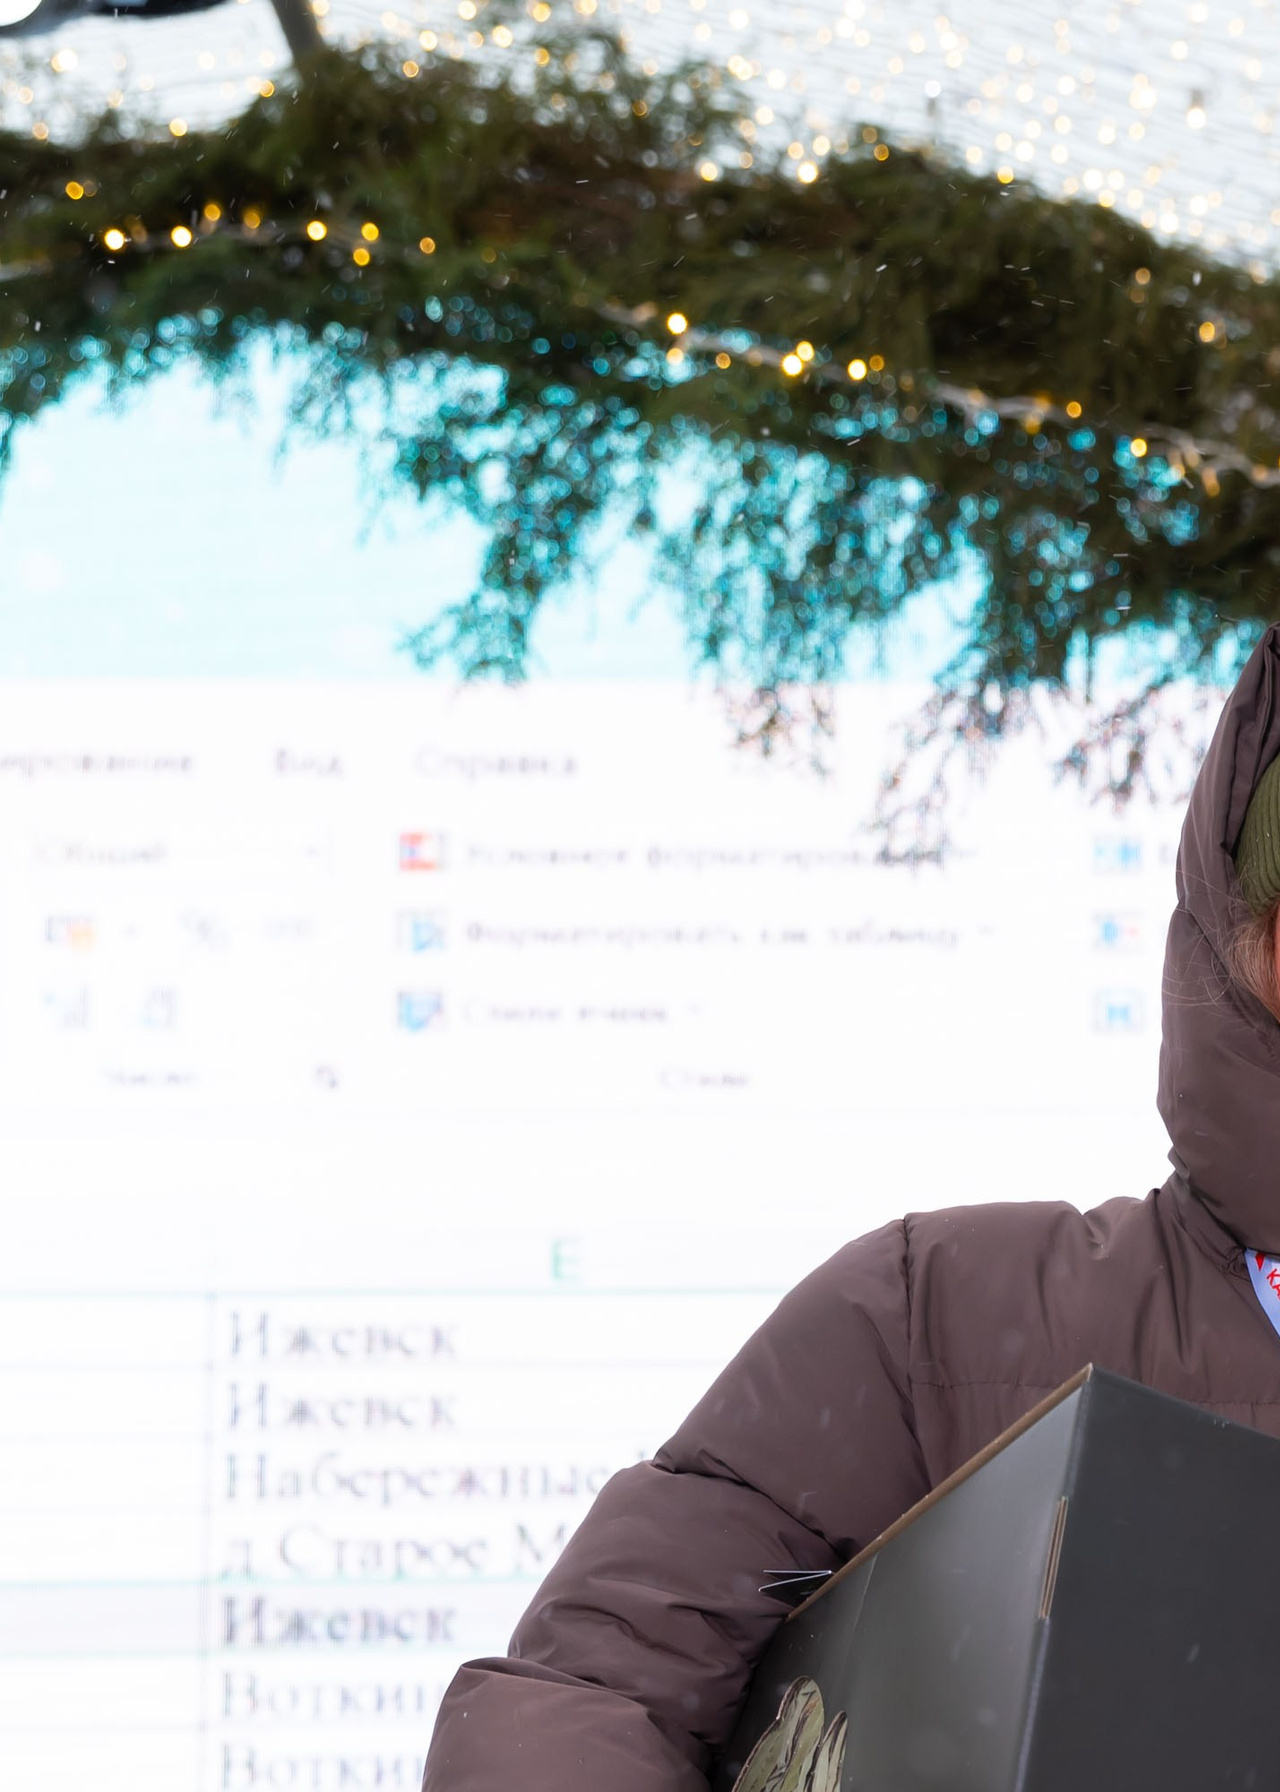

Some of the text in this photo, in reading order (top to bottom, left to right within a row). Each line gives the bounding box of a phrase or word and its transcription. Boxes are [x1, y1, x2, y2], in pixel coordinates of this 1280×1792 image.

[229, 1310, 458, 1360] Ижевск
[228, 1381, 457, 1431] Ижевск
[223, 1594, 457, 1647] Ижевск
